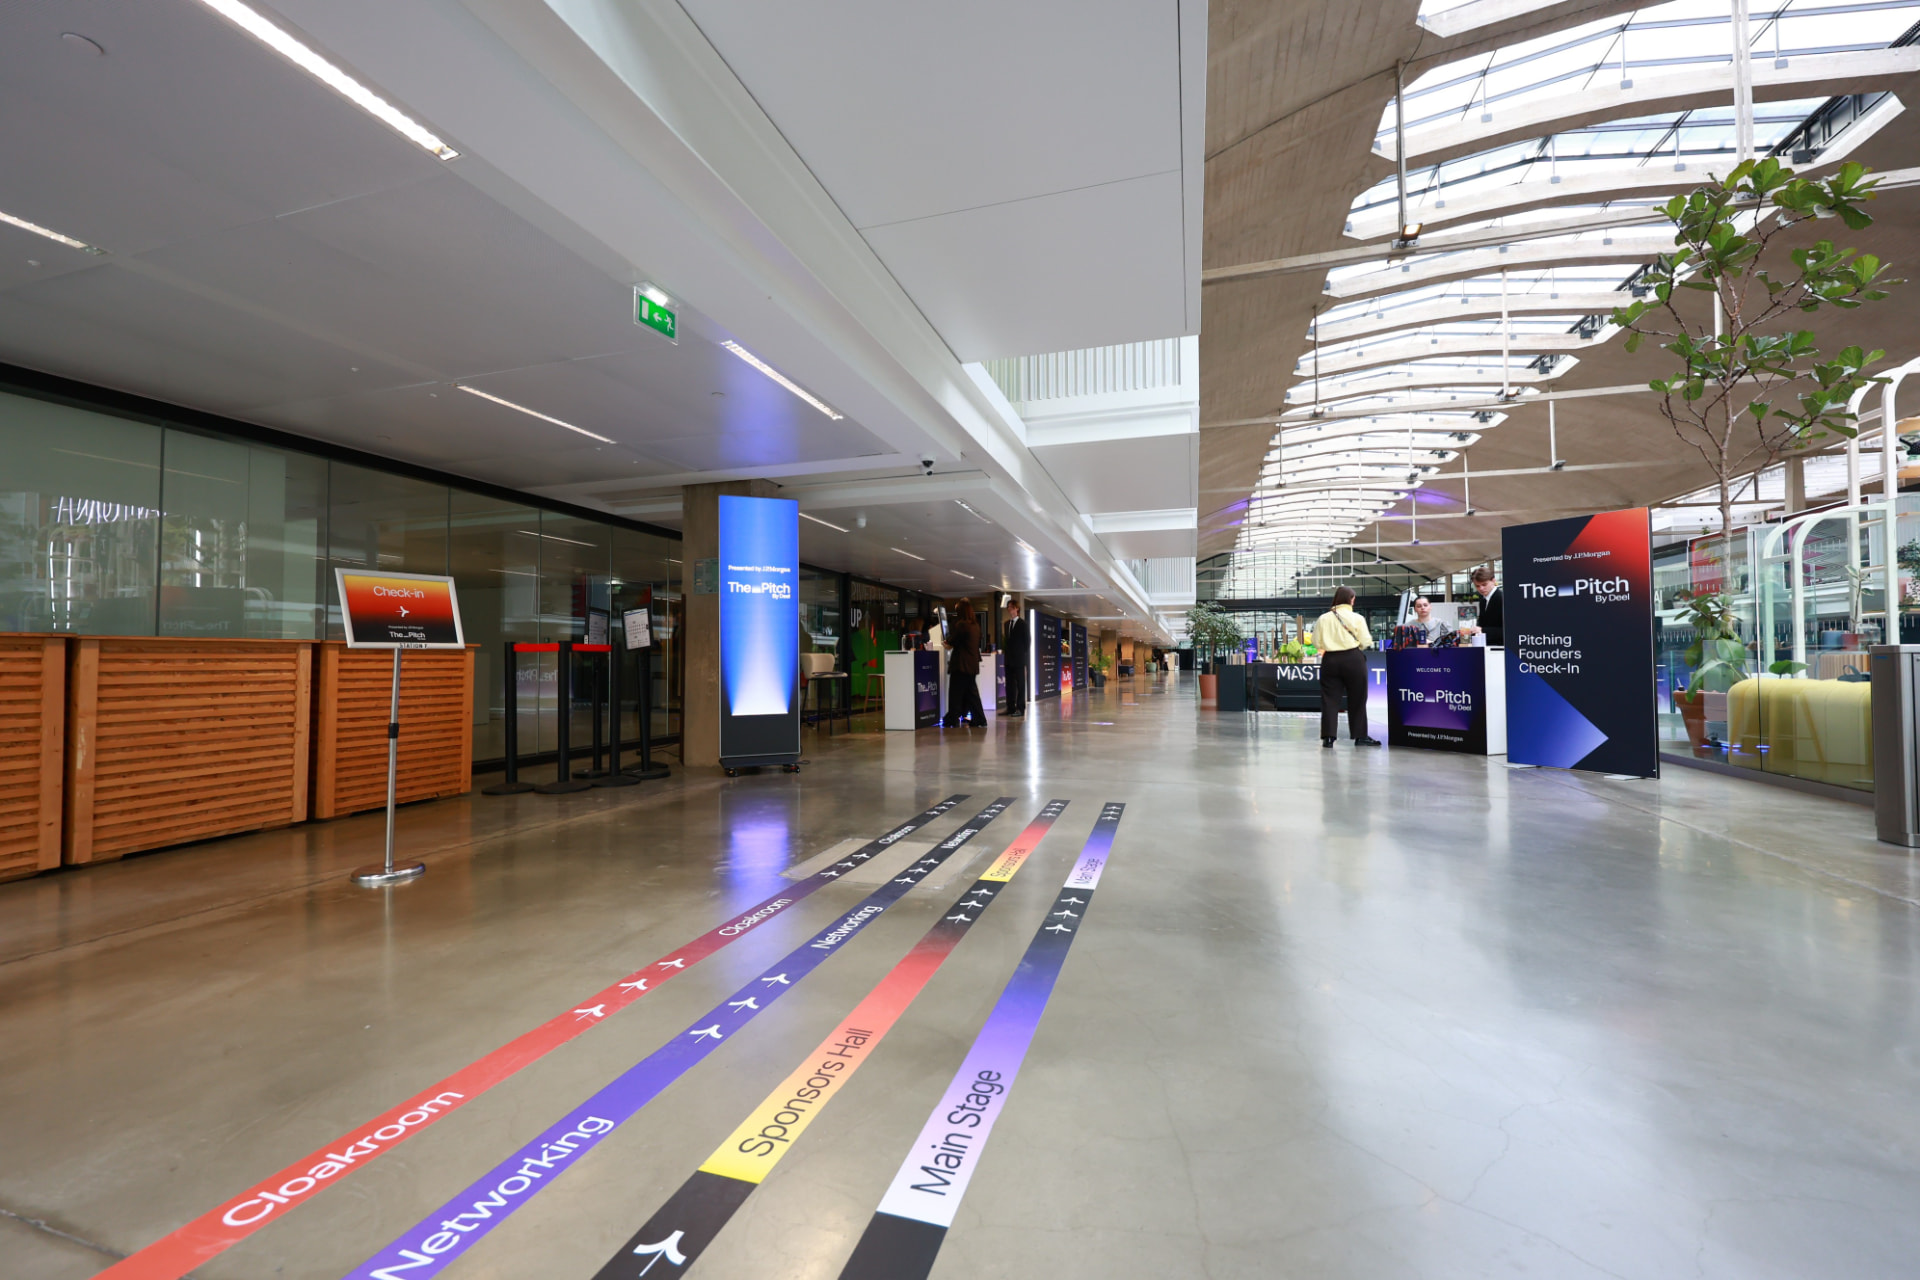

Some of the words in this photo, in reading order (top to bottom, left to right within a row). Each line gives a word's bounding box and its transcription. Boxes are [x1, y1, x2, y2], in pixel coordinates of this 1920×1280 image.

[1533, 555, 1564, 563] Presented
[728, 564, 754, 572] Presented
[373, 586, 425, 598] Check-in
[1596, 594, 1607, 604] By
[1608, 593, 1630, 602] Deel
[850, 608, 862, 628] UP
[1518, 634, 1572, 648] Pitching
[1519, 648, 1582, 660] Founders
[1277, 666, 1320, 680] MAST
[1371, 668, 1386, 685] T
[1518, 662, 1580, 674] Check-In
[1449, 704, 1457, 712] By
[878, 825, 917, 845] Cloakroom
[940, 828, 978, 849] Networking
[990, 853, 1019, 878] Sponsors
[1081, 858, 1103, 875] Stage
[1074, 869, 1093, 885] Main
[718, 898, 793, 936] Cloakroom
[810, 905, 884, 950] Networking
[738, 1060, 845, 1158] Sponsors
[826, 1028, 874, 1058] Hall
[910, 1132, 973, 1196] Main
[947, 1069, 1004, 1128] Stage
[222, 1091, 465, 1227] Cloakroom
[369, 1115, 615, 1280] Networking
